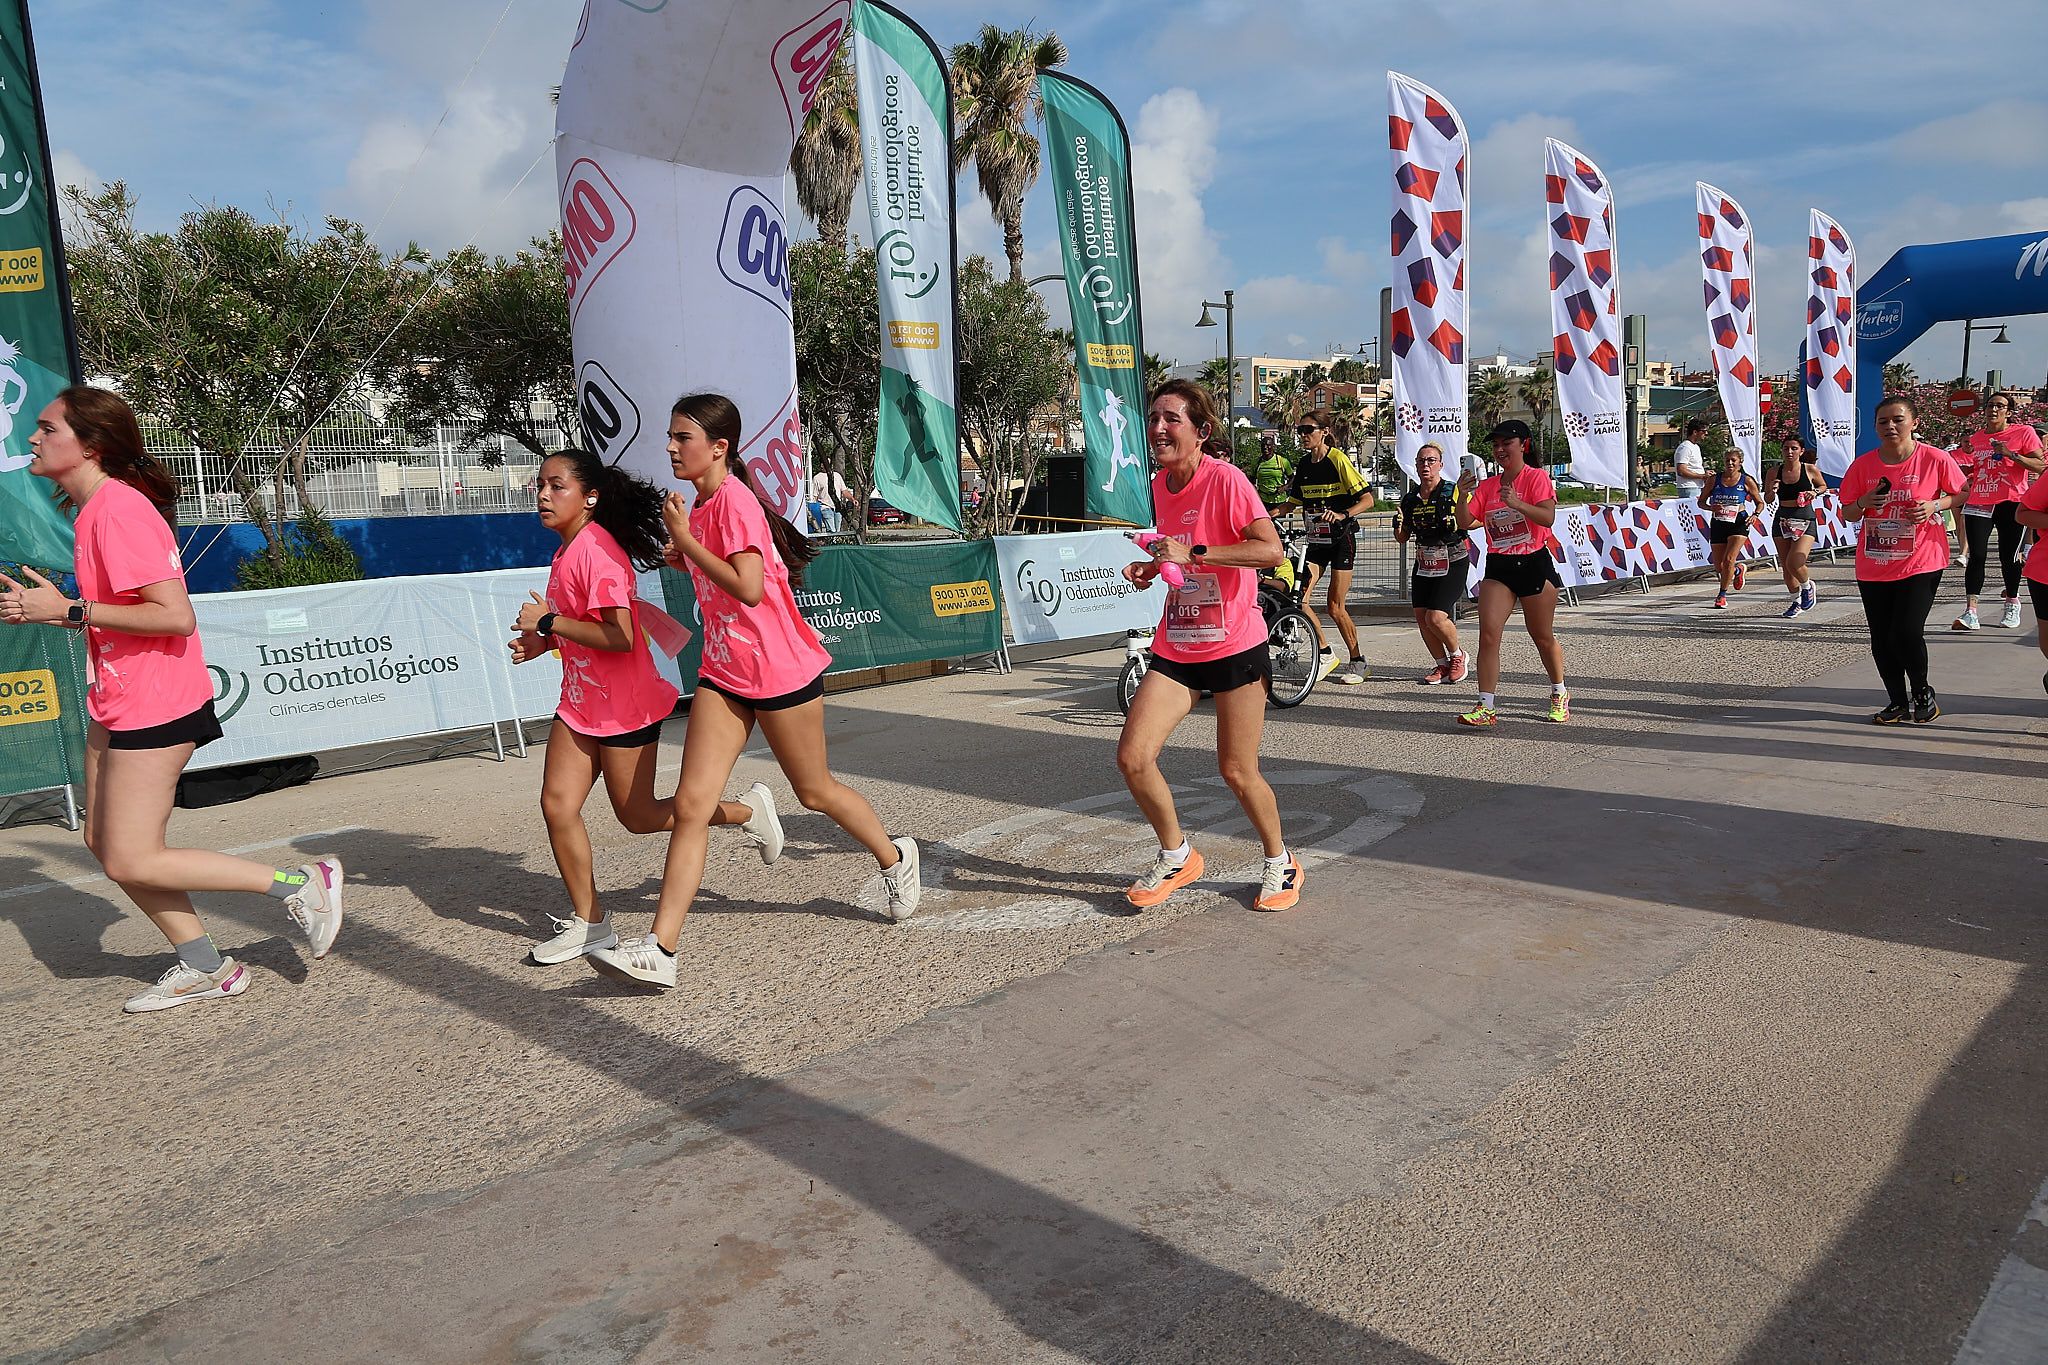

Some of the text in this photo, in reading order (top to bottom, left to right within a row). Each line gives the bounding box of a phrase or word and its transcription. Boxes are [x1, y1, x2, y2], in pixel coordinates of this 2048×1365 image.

[1499, 524, 1514, 533] 016
[1879, 537, 1898, 545] 016
[1060, 566, 1115, 583] Institutos
[935, 586, 988, 600] 900 131 002
[1065, 580, 1143, 601] Odontológico
[938, 599, 990, 611] www.ioa.es
[1178, 605, 1200, 617] 016
[256, 634, 393, 667] Institutos
[263, 654, 460, 695] Odontológicos
[0, 679, 46, 698] 002
[269, 691, 387, 717] Clínicas dentales
